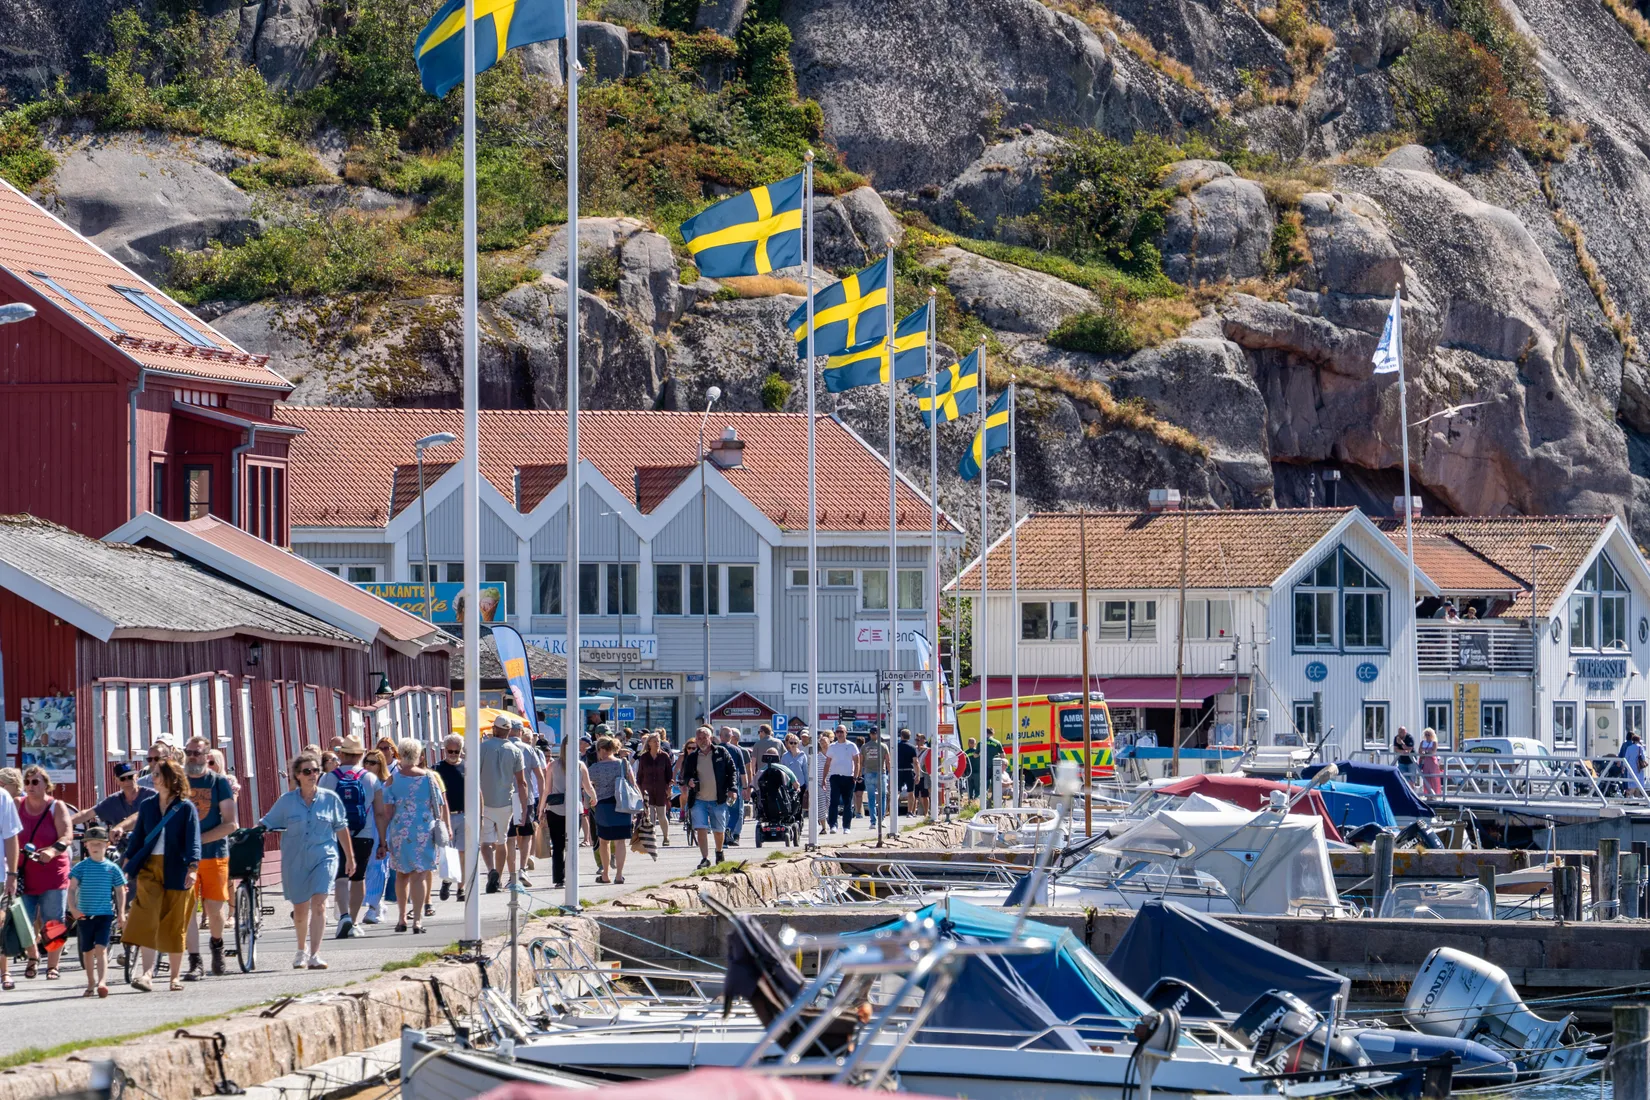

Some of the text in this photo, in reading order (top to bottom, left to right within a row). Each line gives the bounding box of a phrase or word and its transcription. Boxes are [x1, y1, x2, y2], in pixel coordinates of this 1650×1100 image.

[1577, 658, 1626, 678] TERRASSEN
[628, 678, 674, 690] CENTER
[776, 716, 785, 730] P
[1063, 713, 1105, 723] AMBUANS
[1006, 729, 1045, 741] ABULANS
[1417, 960, 1455, 1019] HONDA
